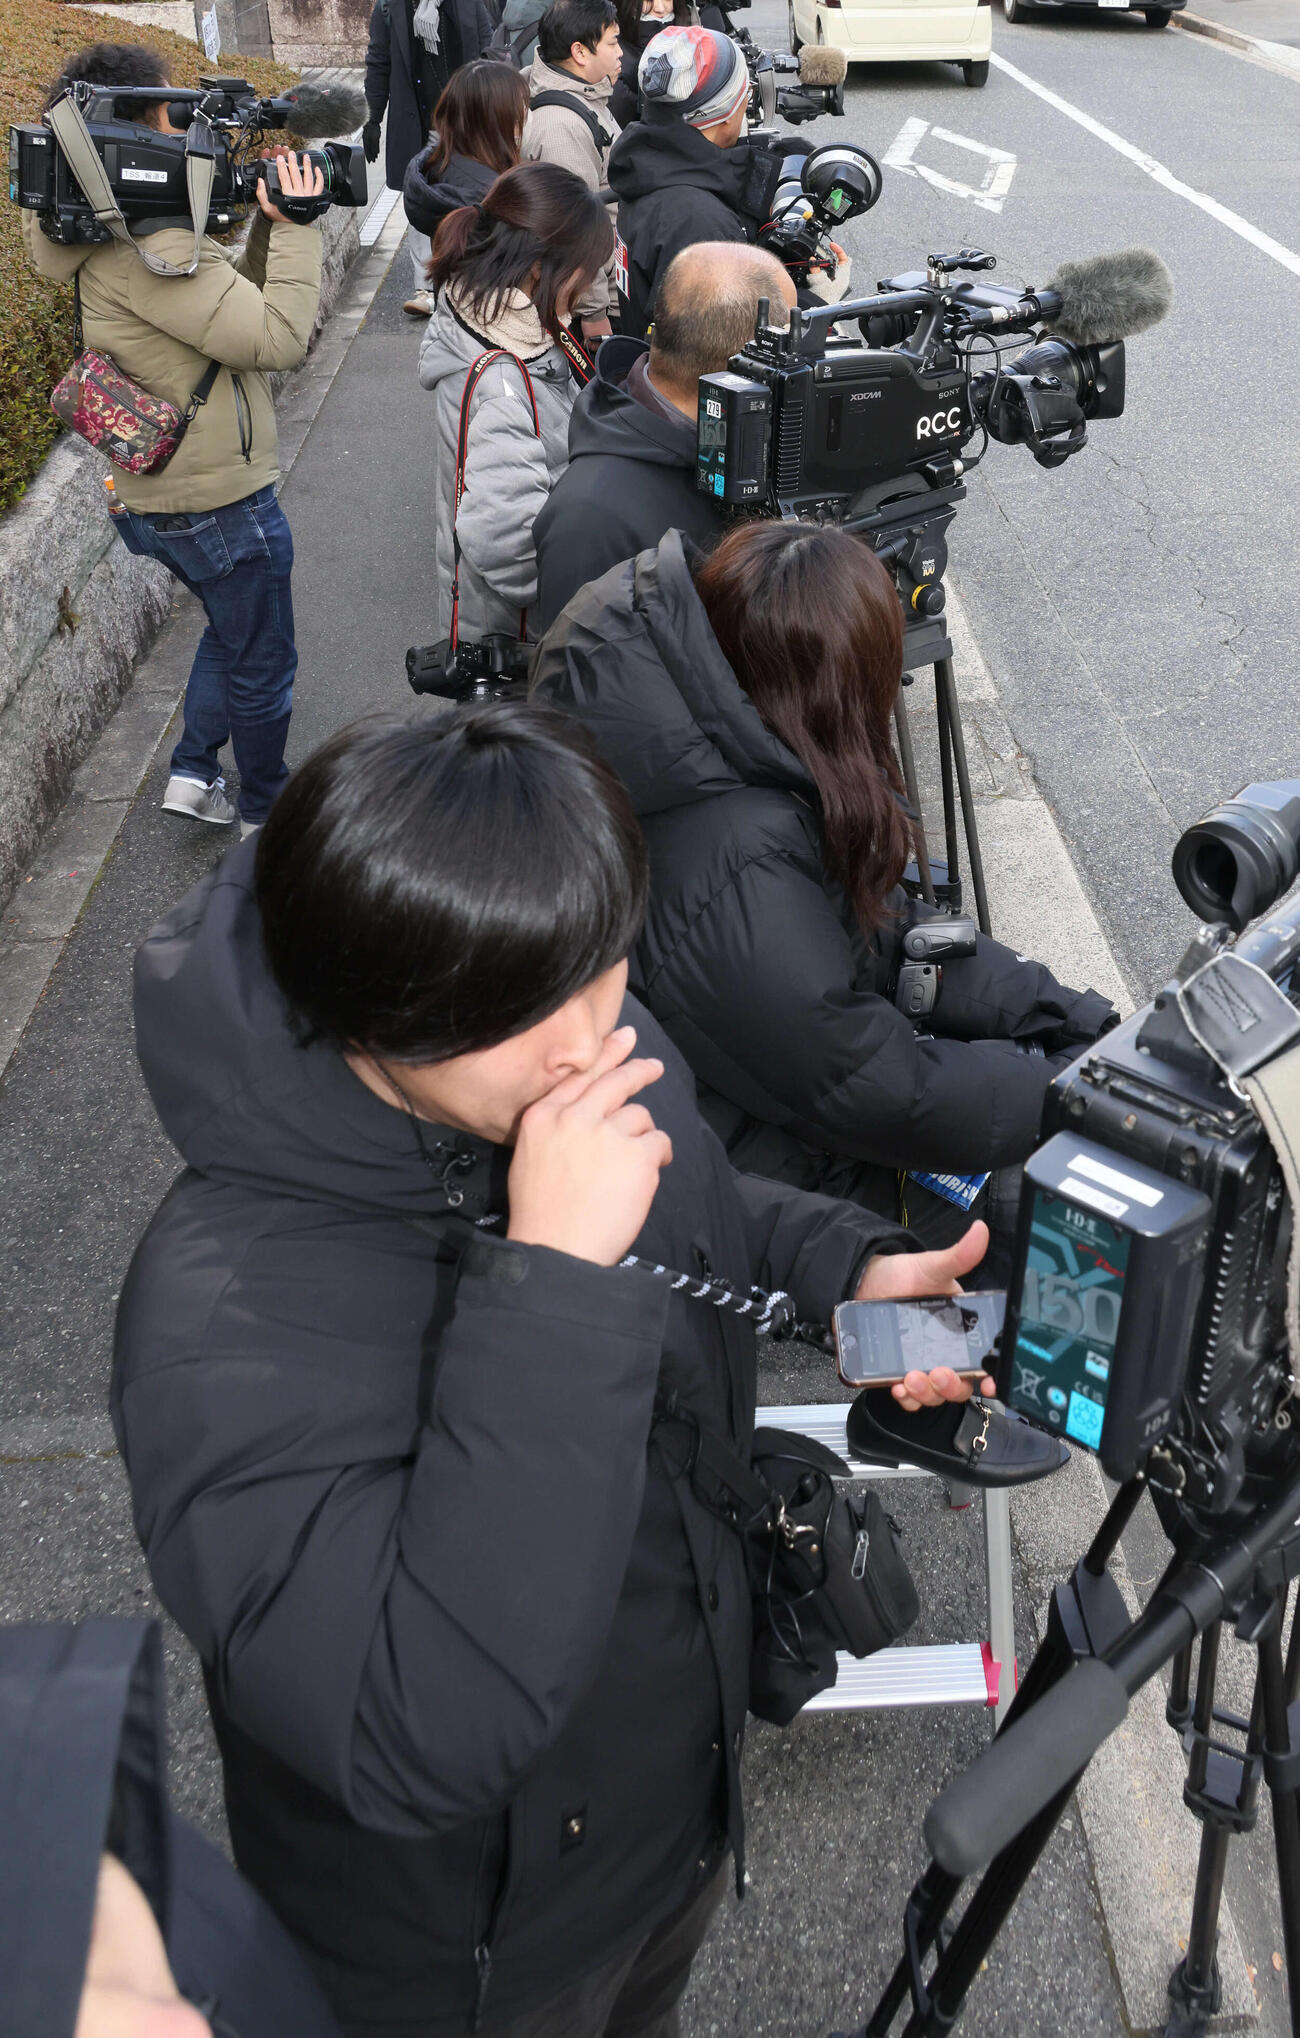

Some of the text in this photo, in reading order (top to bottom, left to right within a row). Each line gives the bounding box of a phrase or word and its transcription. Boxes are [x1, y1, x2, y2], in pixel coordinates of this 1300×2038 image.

[123, 170, 141, 179] TSS
[560, 331, 588, 370] Canon
[849, 390, 882, 401] XDCAM
[938, 388, 960, 399] SONY
[708, 401, 721, 417] 279
[917, 406, 961, 440] RCC
[1020, 1267, 1123, 1347] 150
